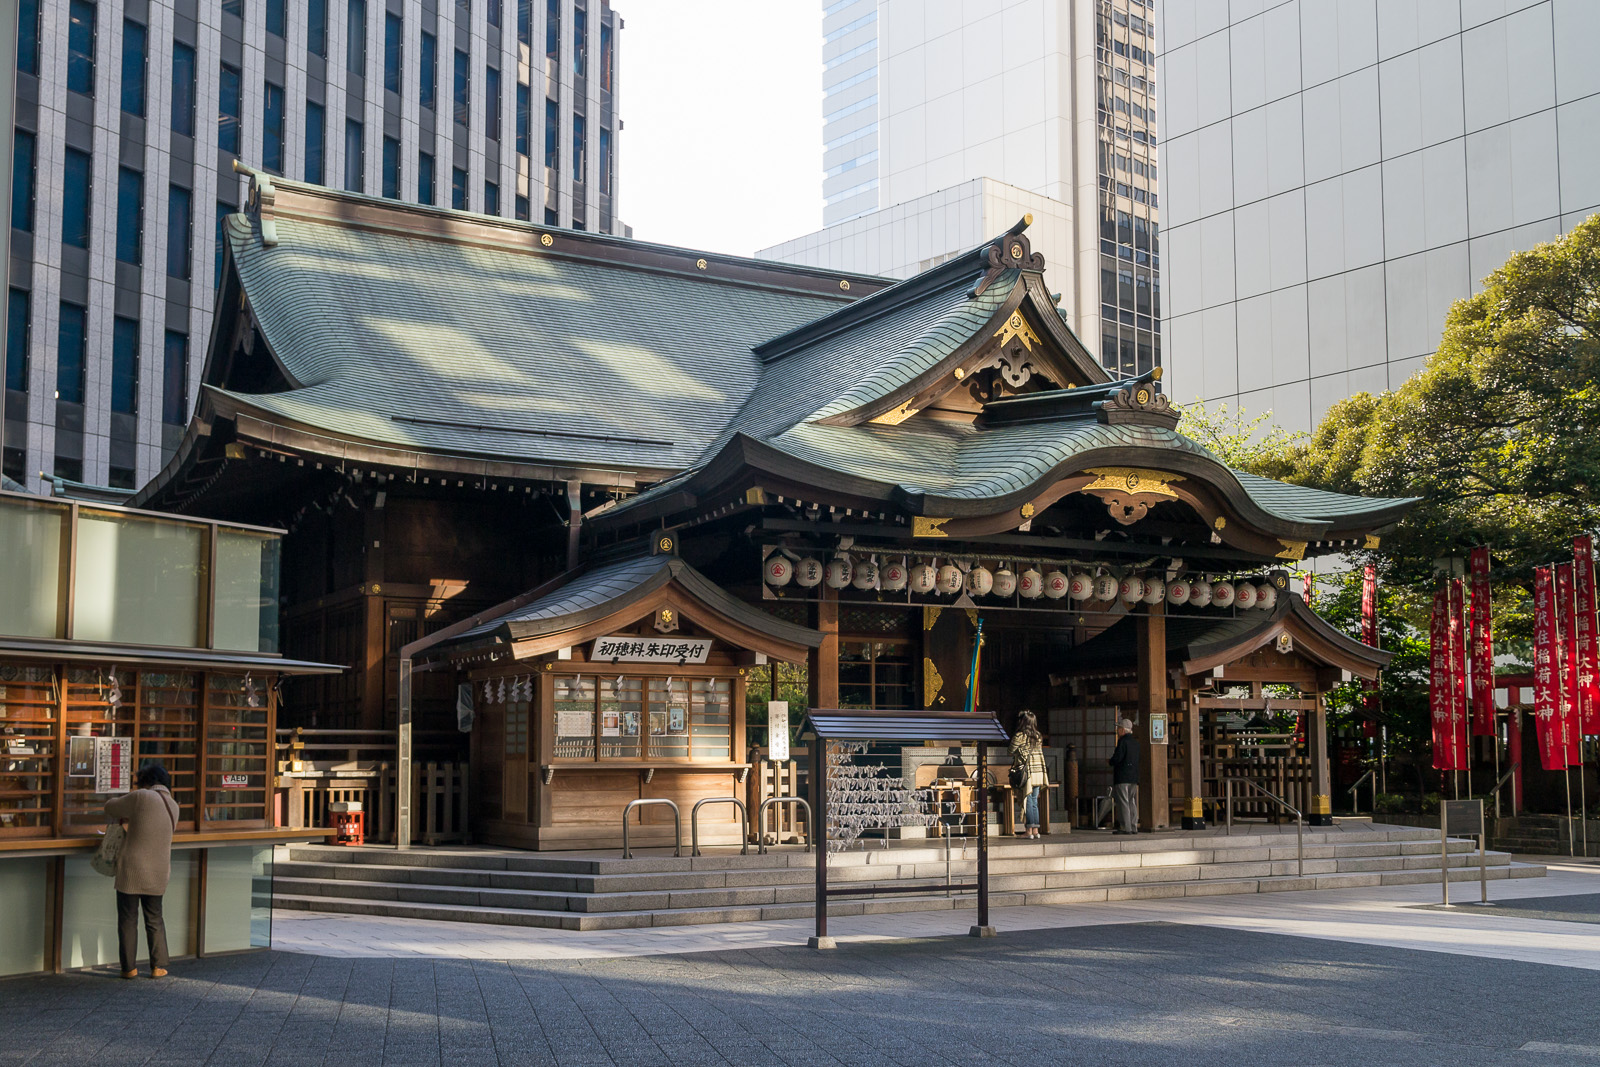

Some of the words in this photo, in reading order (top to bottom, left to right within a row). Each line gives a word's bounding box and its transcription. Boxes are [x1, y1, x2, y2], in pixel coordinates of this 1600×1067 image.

[1537, 591, 1554, 722] 喜代住稲荷大神
[231, 774, 246, 782] AED
